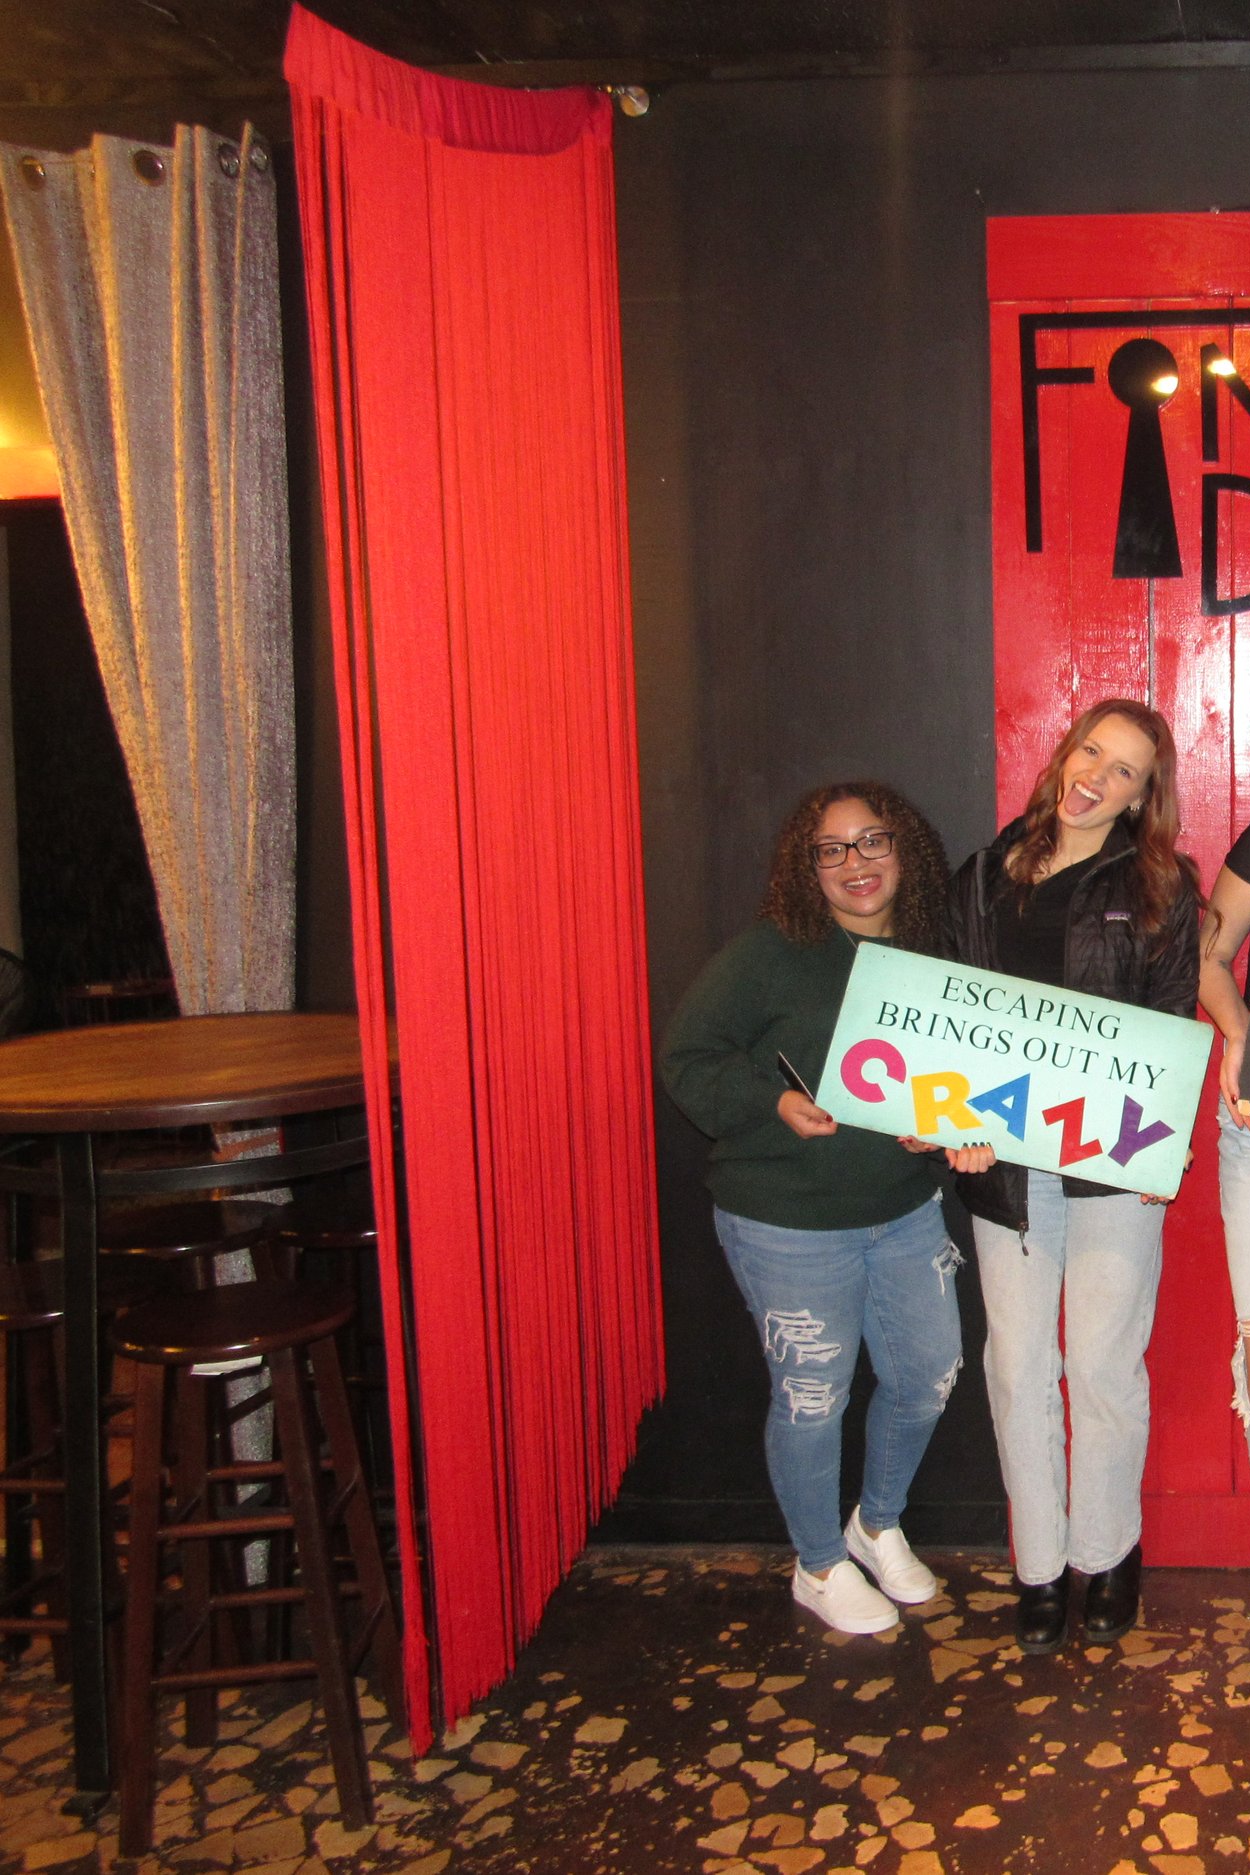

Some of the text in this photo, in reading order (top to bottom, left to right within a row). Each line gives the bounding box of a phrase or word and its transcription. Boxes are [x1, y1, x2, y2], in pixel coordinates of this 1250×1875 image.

[876, 1000, 1167, 1091] BRINGS OUT MY
[940, 975, 1122, 1041] ESCAPING
[839, 1038, 1177, 1168] CRAZY
